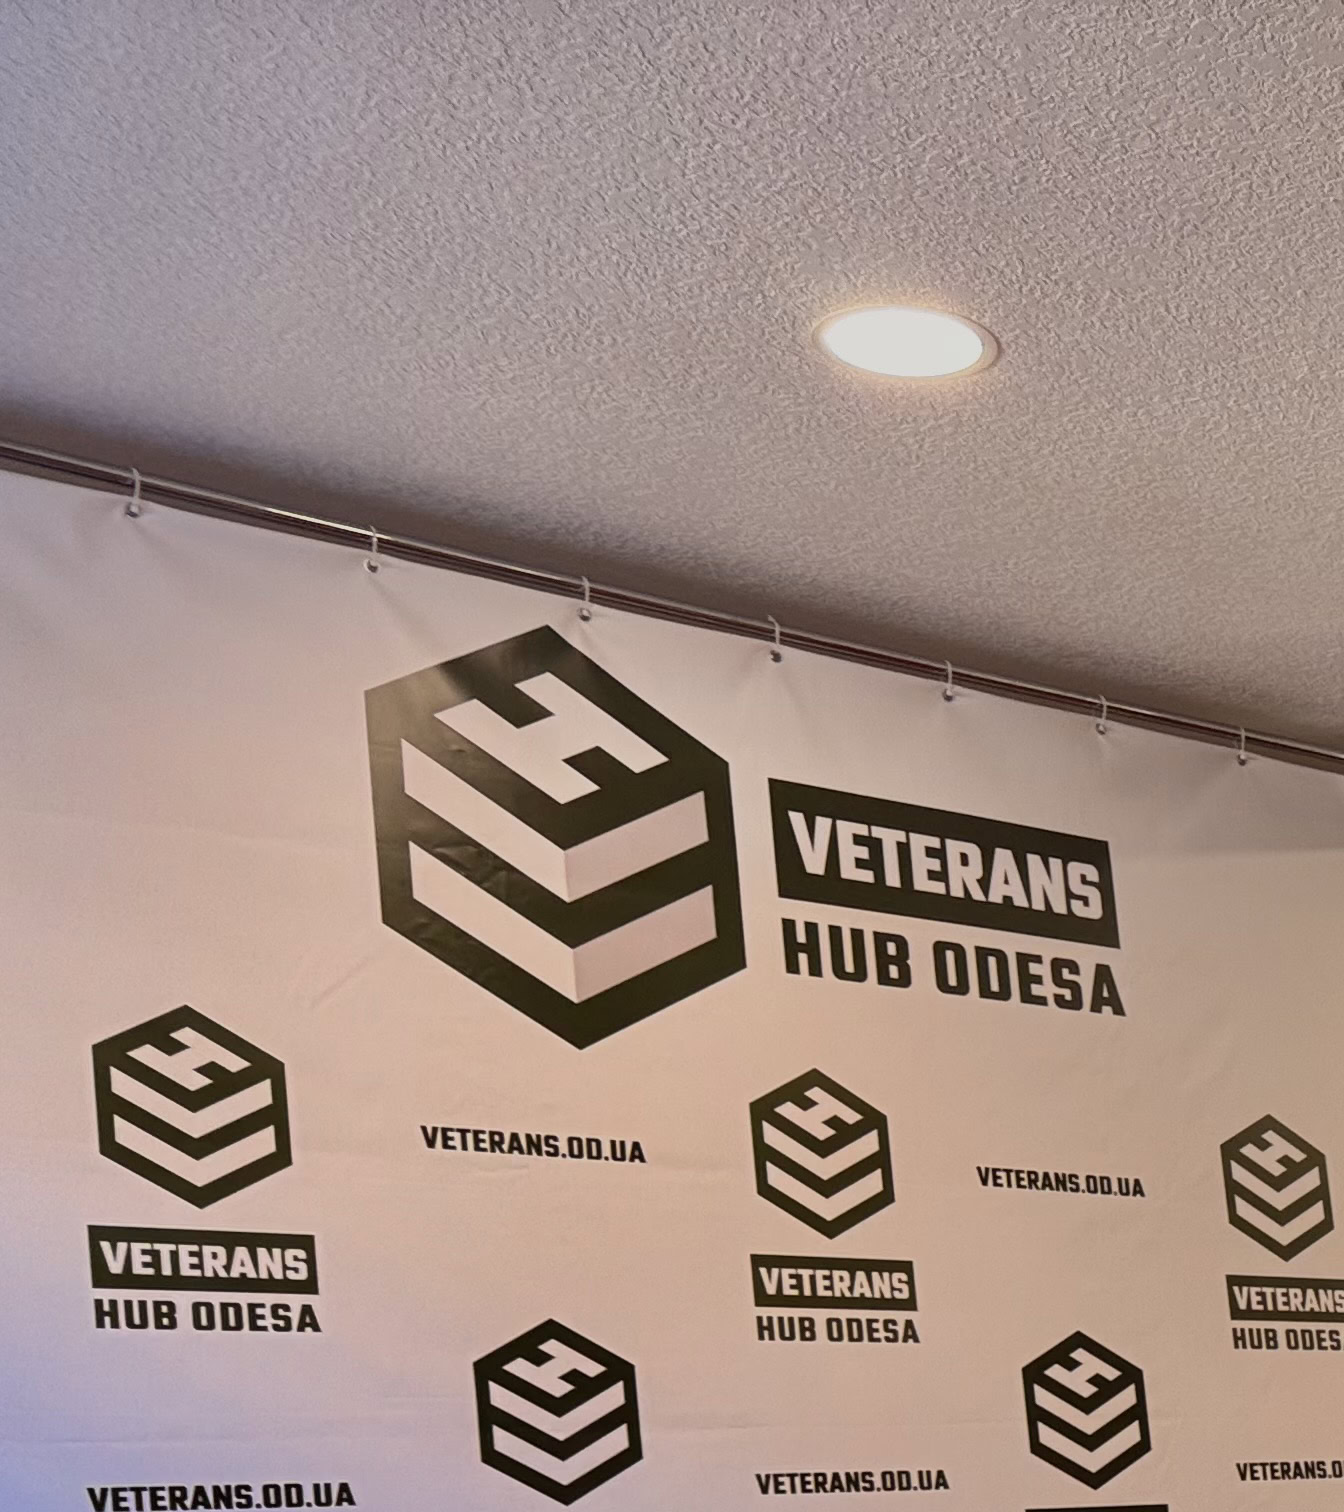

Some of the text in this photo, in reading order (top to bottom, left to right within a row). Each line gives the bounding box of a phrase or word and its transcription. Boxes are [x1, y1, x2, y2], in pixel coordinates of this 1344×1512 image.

[788, 811, 1102, 919] VETERANS
[782, 918, 1126, 1016] HUB ODESA
[420, 1126, 646, 1163] VETERANS.OD.UA
[976, 1166, 1145, 1197] VETERANS.OD.UA
[100, 1241, 308, 1280] VETERANS
[759, 1267, 909, 1299] VETERANS
[94, 1299, 321, 1332] HUB ODESA
[756, 1316, 920, 1343] HUB ODESA
[1232, 1328, 1278, 1349] HUB
[87, 1483, 356, 1512] VETERANS.OD.UA
[756, 1470, 949, 1494] VETERANS.OD.UA
